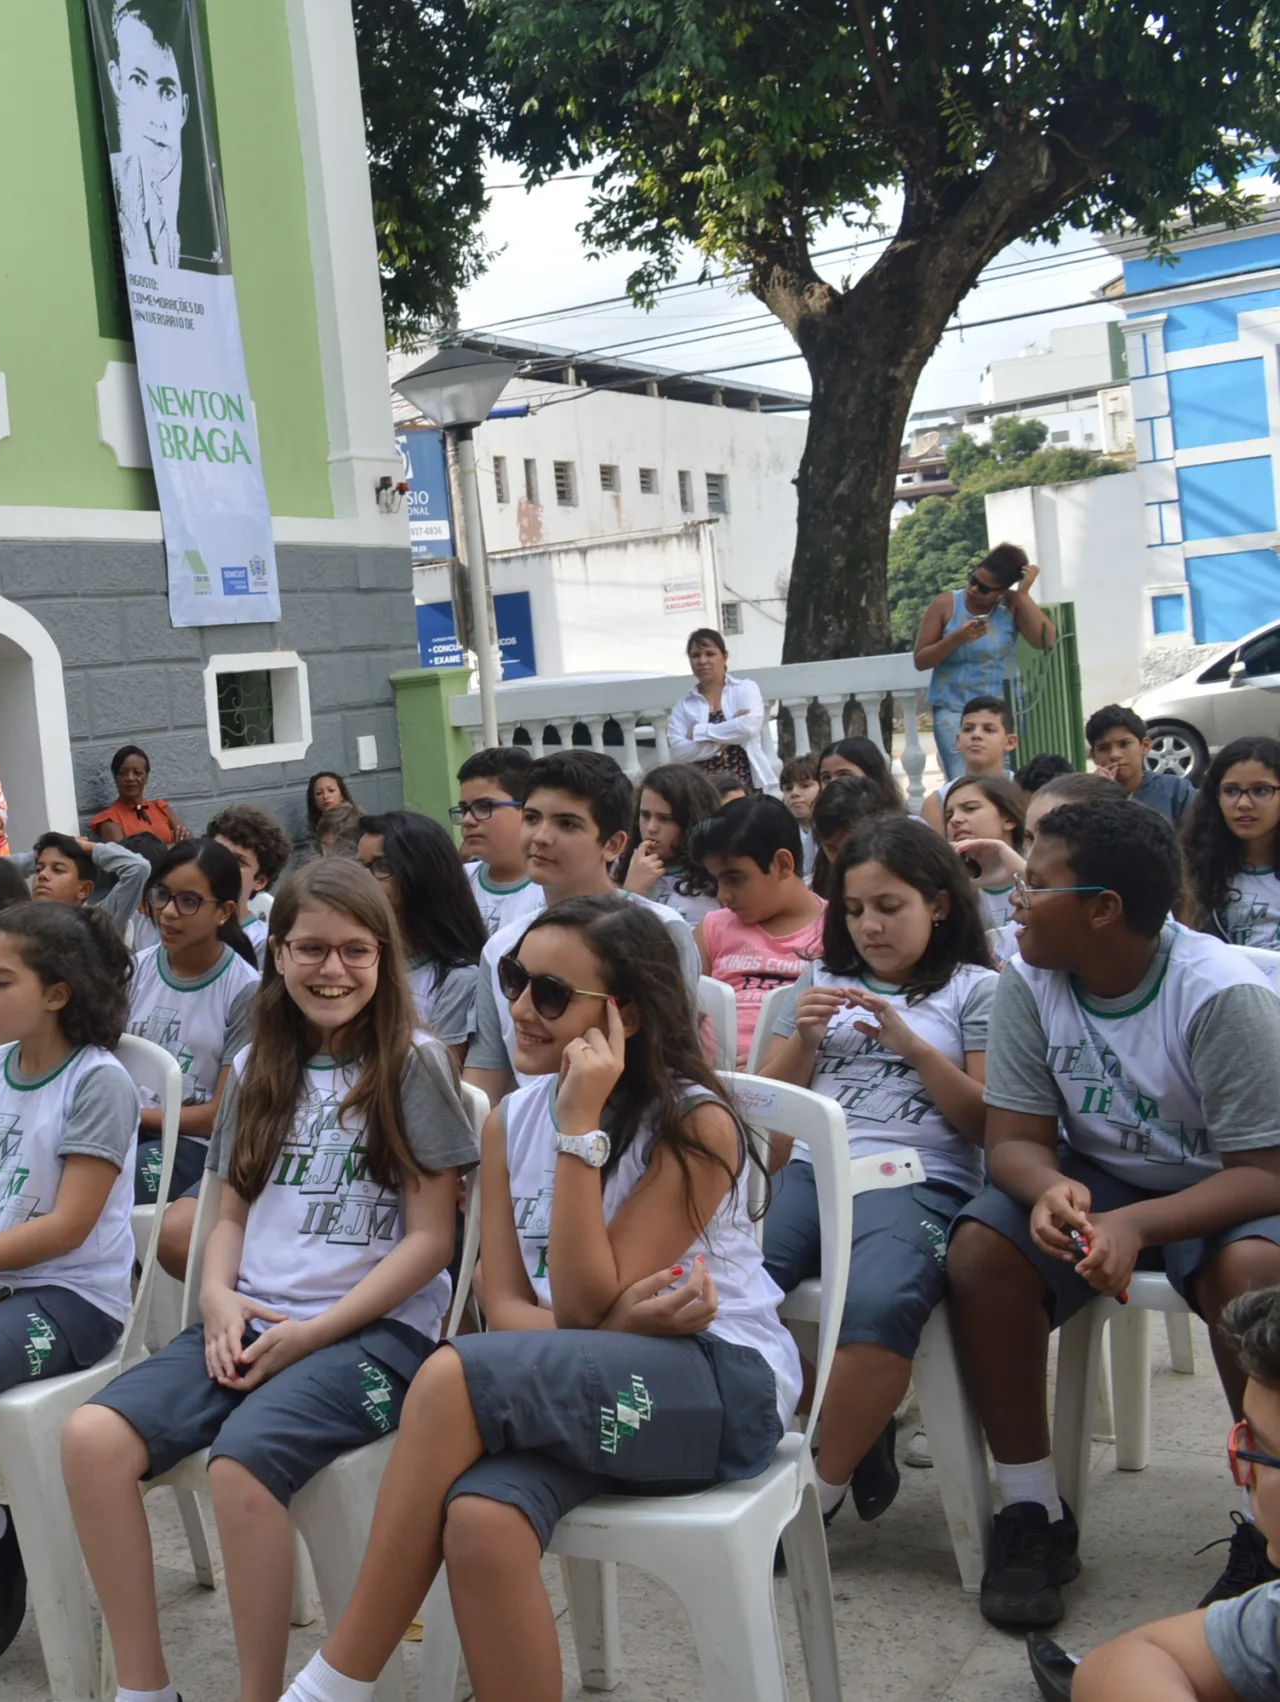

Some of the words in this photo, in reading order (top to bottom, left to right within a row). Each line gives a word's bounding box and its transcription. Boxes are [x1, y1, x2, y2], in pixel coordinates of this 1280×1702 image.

[194, 302, 205, 316] DO
[146, 384, 245, 422] NEWTON
[156, 421, 252, 465] BRAGA
[434, 655, 461, 665] EXAME
[719, 953, 762, 971] KINGS
[835, 1084, 937, 1125] IEJM
[273, 1144, 369, 1186] IEJM
[298, 1194, 400, 1241] IEJM
[631, 1374, 653, 1421] IEJM
[600, 1406, 620, 1455] IEJM
